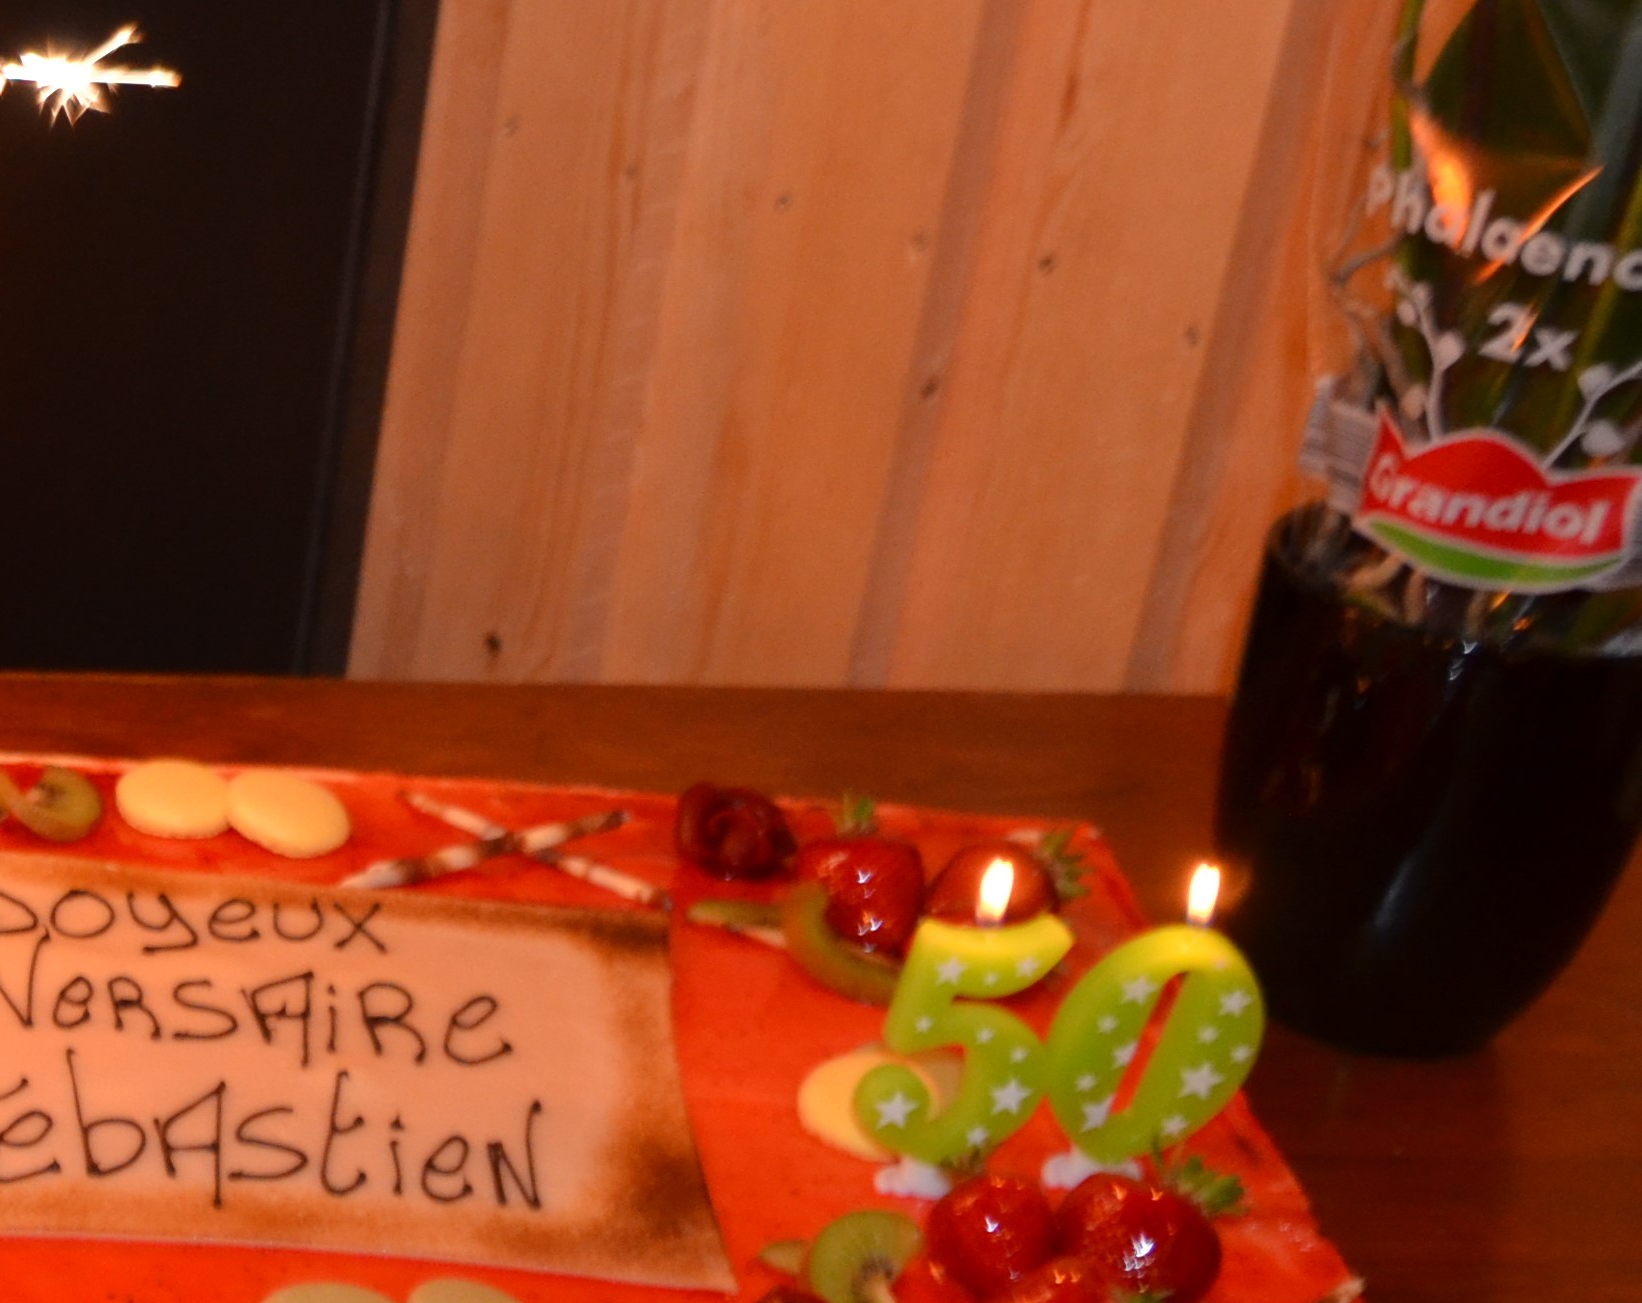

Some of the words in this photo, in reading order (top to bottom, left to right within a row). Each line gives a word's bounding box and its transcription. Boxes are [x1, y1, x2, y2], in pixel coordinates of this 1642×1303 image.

[1479, 304, 1578, 370] 2x
[1370, 458, 1611, 546] Grandiol
[853, 912, 1264, 1165] 50
